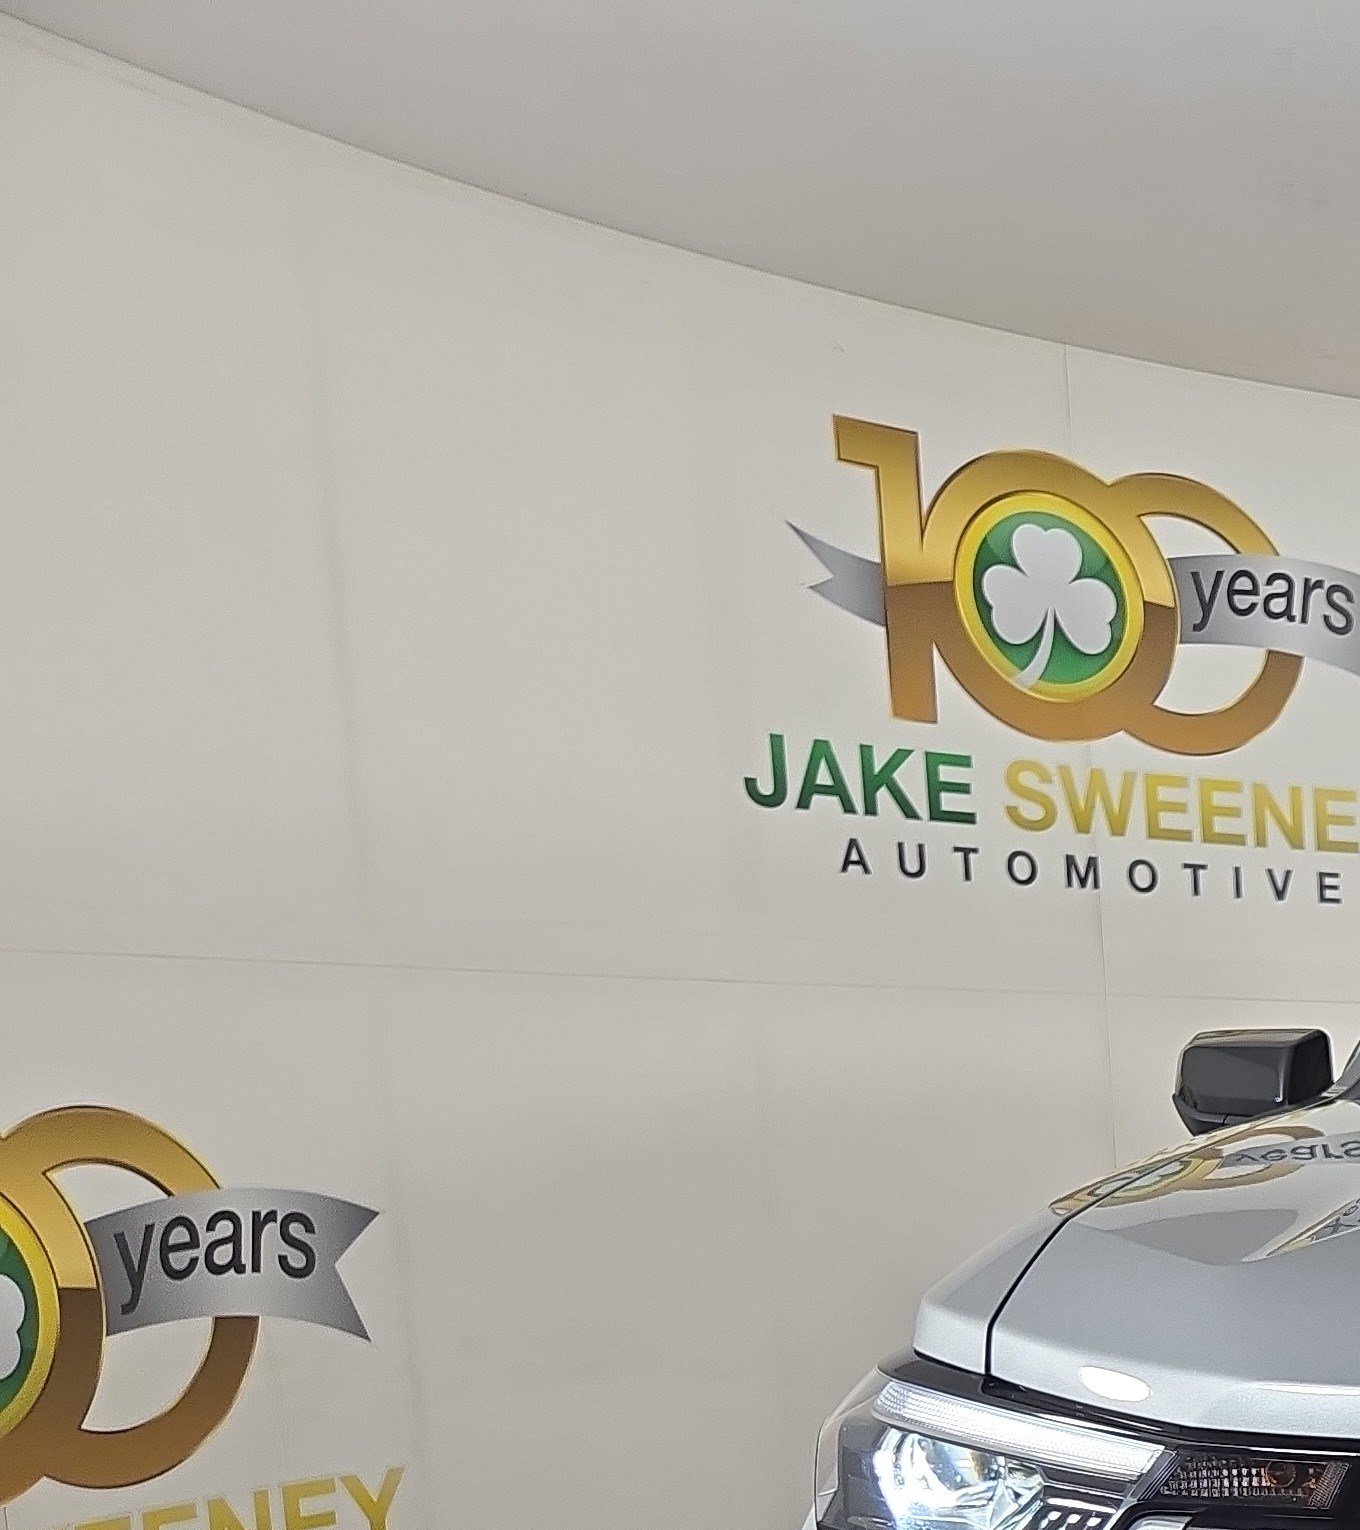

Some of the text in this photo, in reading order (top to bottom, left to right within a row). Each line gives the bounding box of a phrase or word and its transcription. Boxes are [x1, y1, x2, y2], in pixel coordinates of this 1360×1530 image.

[1189, 566, 1356, 636] years
[743, 733, 977, 826] JAKE
[839, 837, 1343, 905] AUTOMOTIVE
[113, 1208, 317, 1316] years
